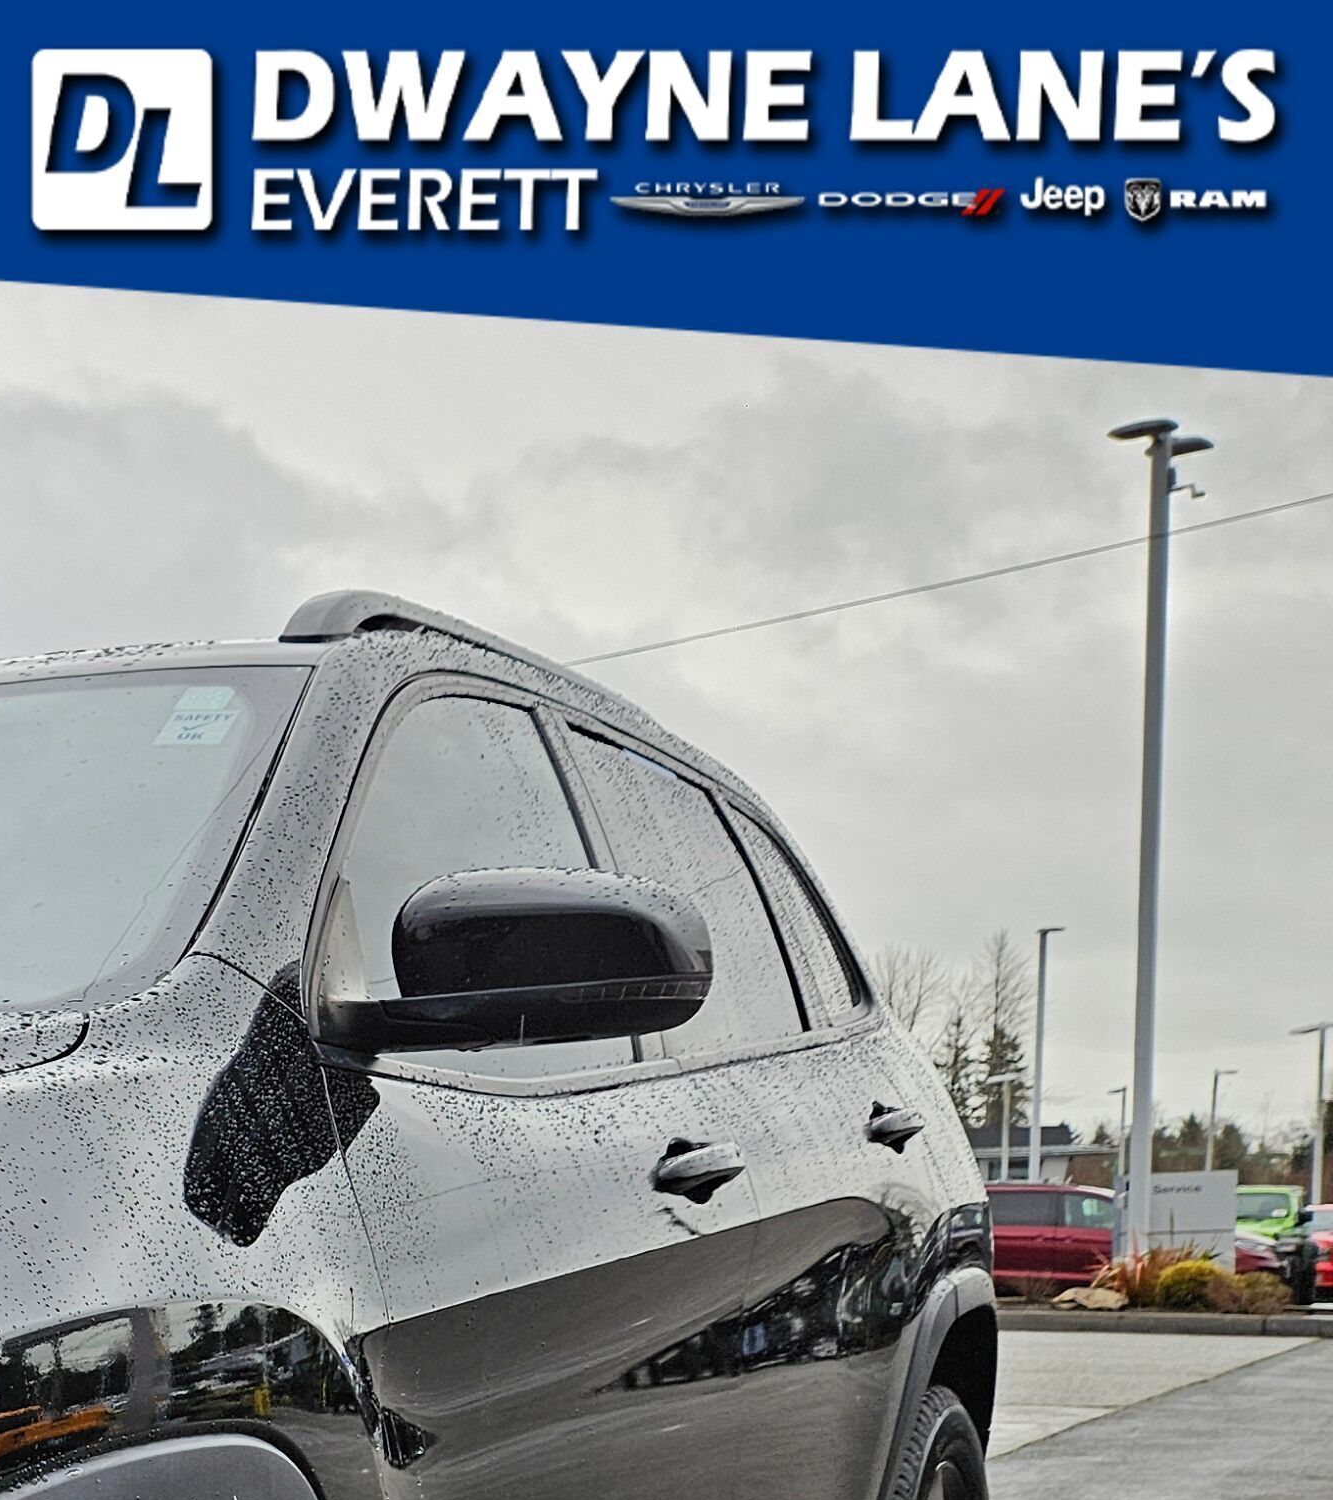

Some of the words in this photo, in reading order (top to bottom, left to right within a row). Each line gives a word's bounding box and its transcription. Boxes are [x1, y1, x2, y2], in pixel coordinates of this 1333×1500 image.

[174, 713, 234, 721] SAFETY
[177, 732, 205, 740] OK
[1153, 1184, 1203, 1194] Service
